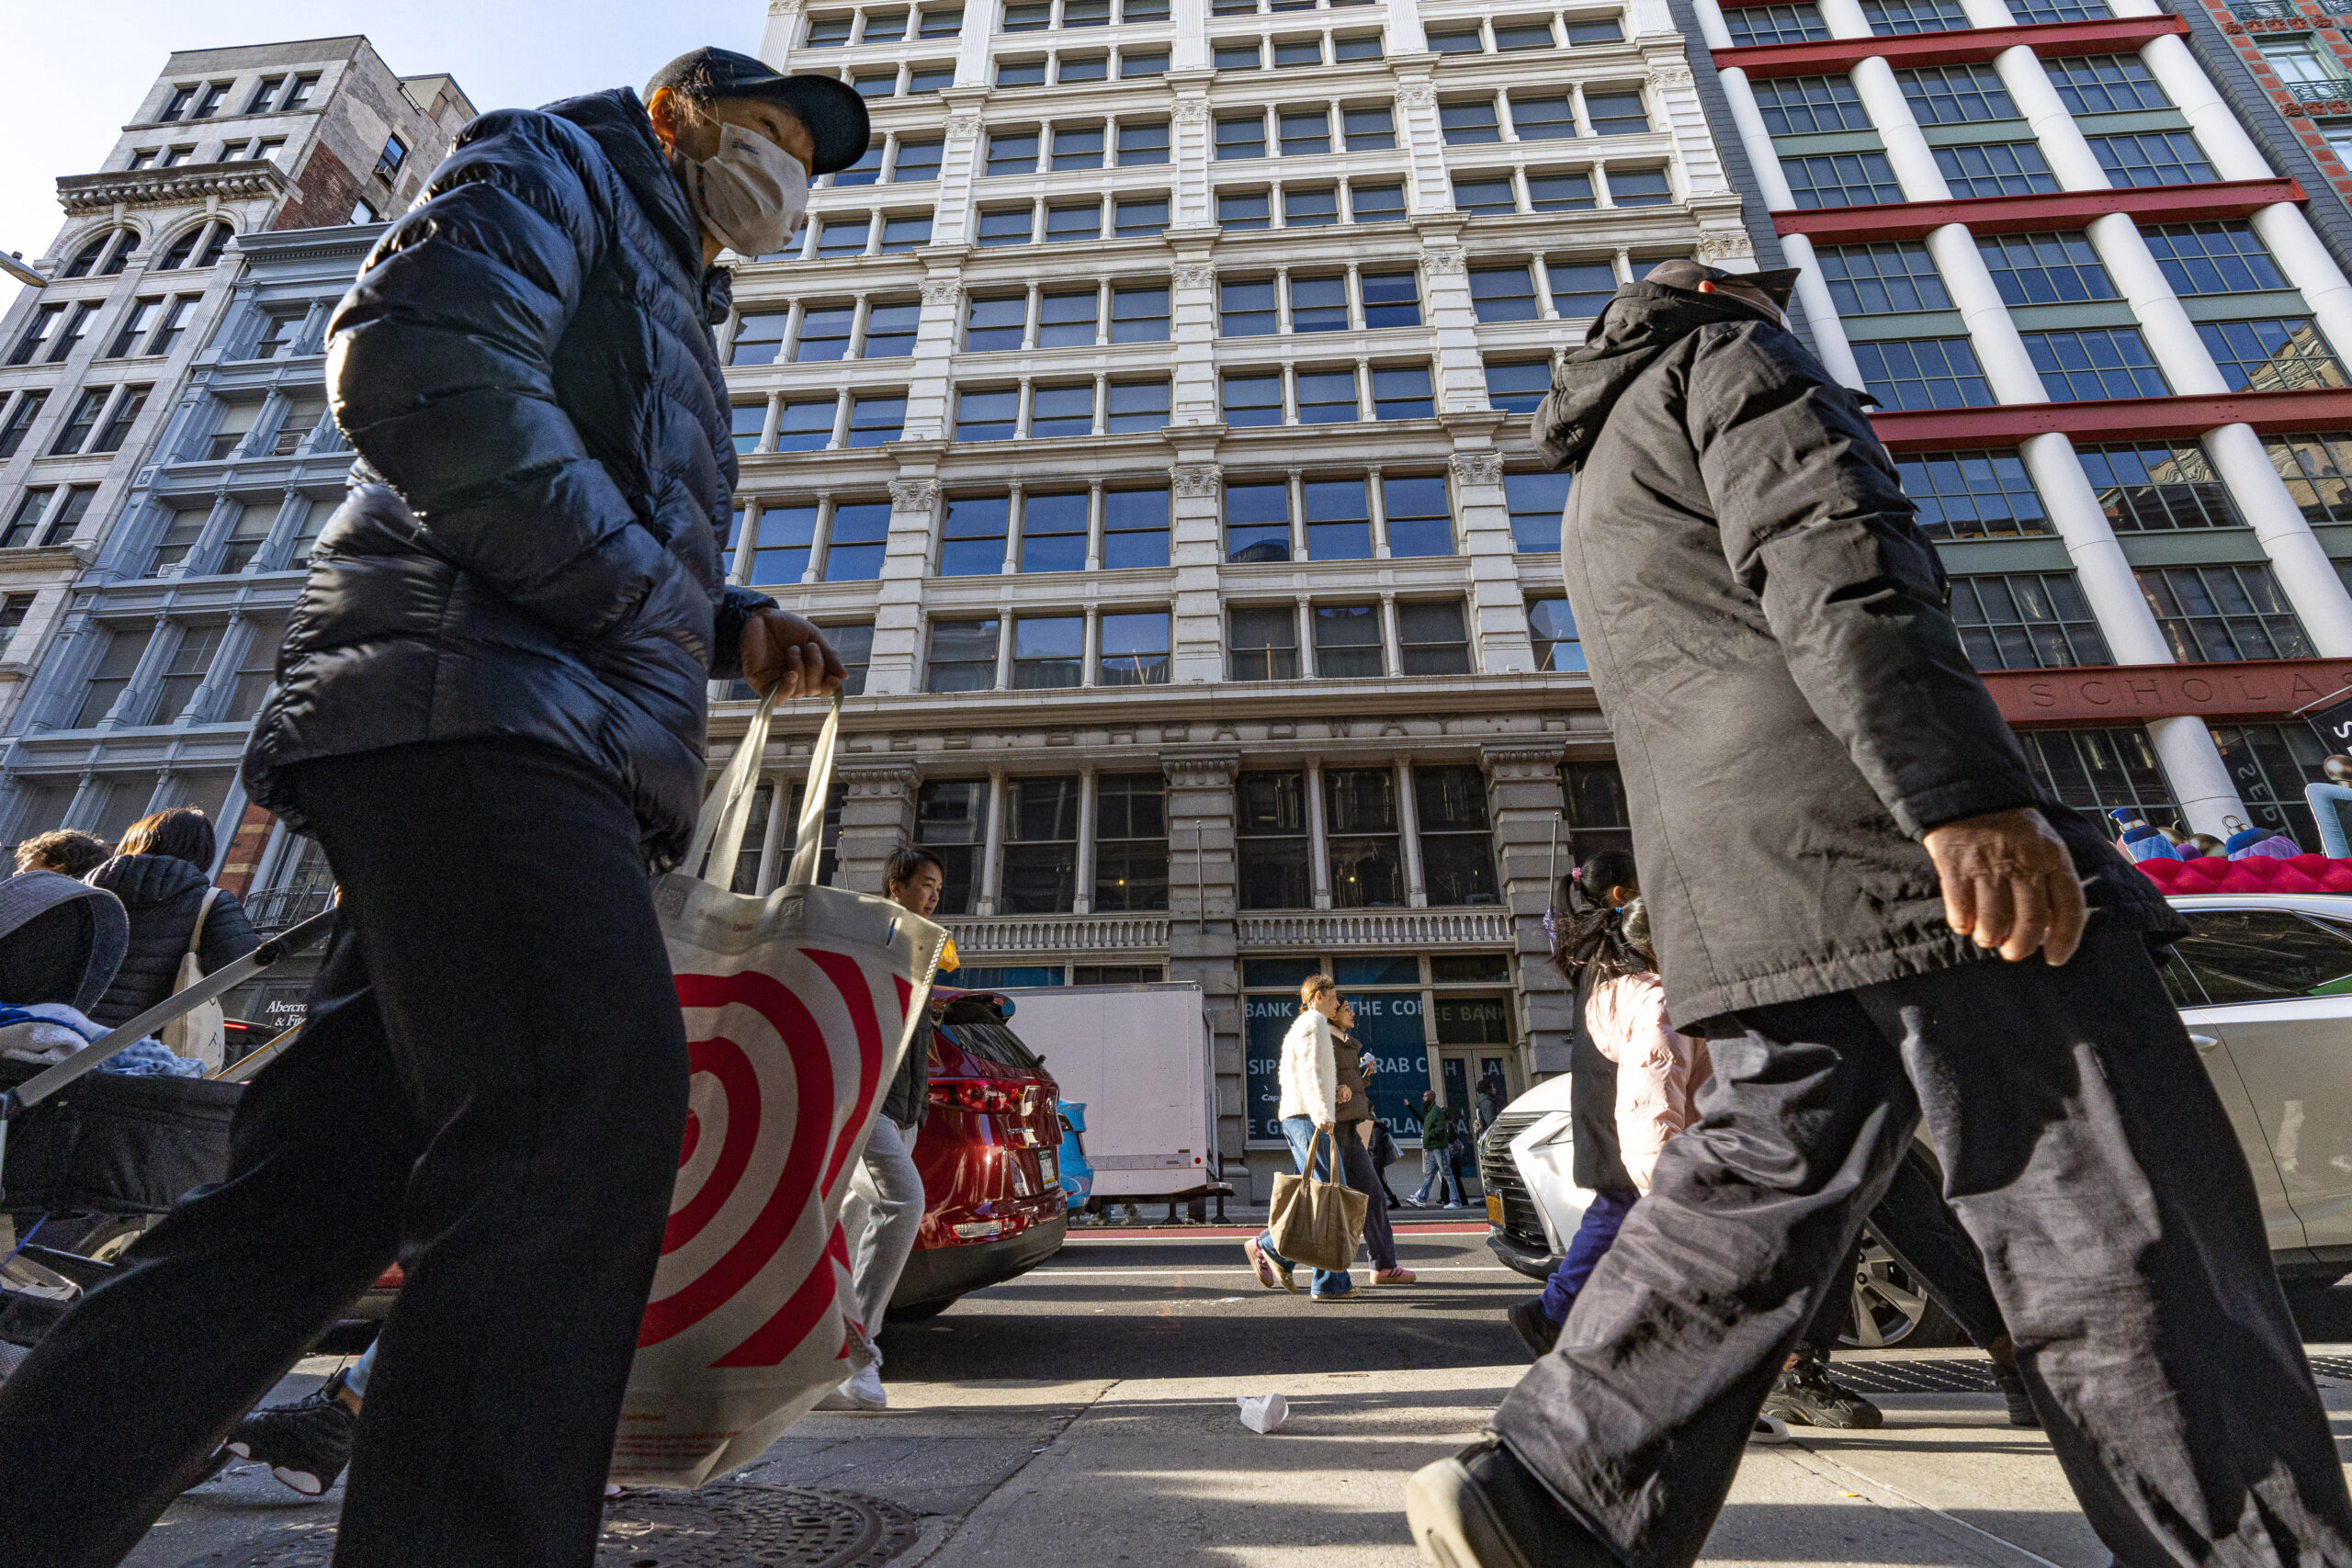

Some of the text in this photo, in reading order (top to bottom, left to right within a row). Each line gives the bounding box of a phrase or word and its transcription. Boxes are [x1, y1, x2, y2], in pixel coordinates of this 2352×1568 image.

[1245, 1001, 1293, 1018] BANK
[1249, 1059, 1276, 1075] SIP
[1374, 1057, 1410, 1073] RAB
